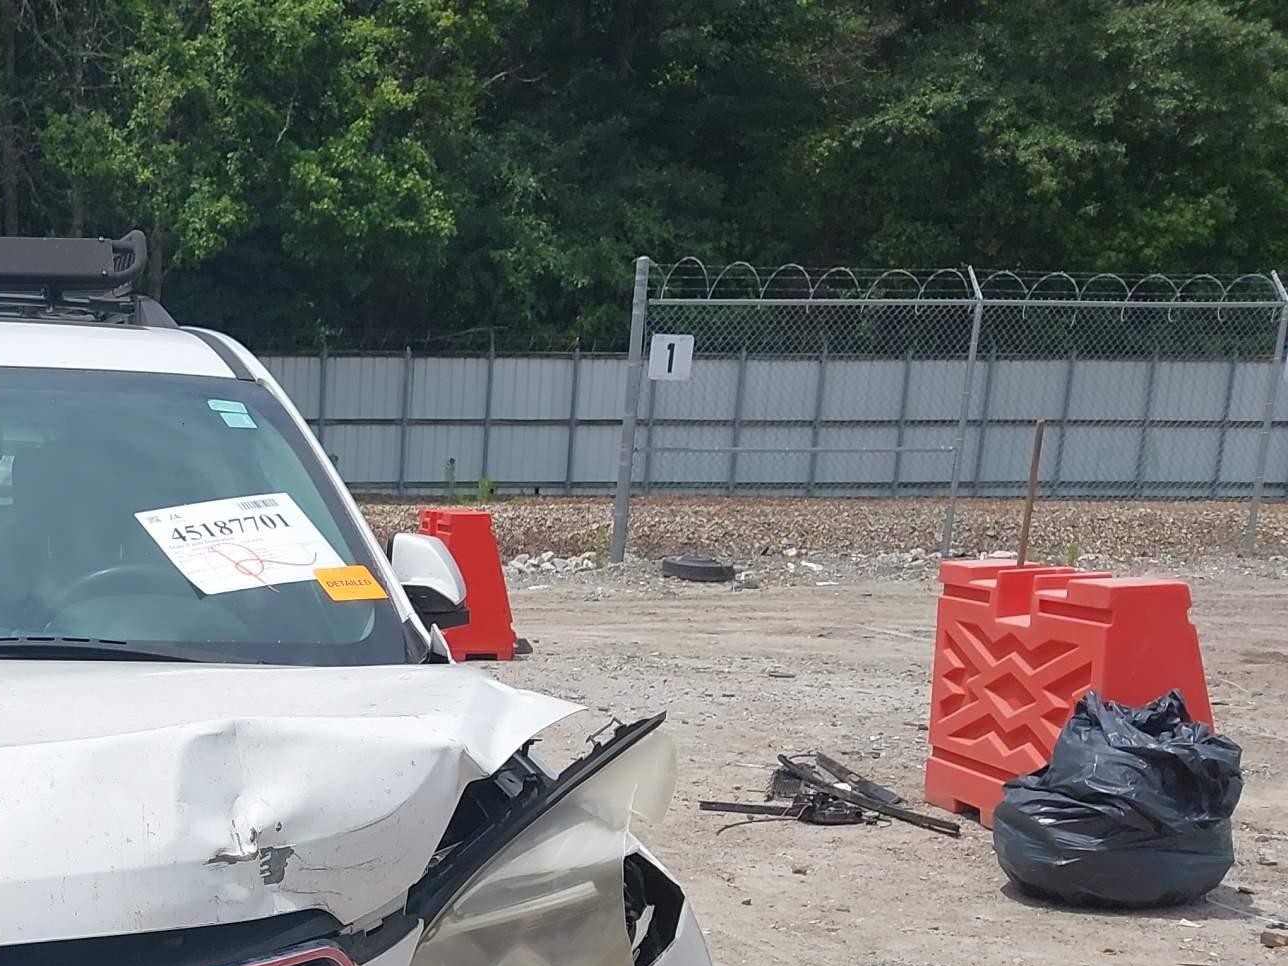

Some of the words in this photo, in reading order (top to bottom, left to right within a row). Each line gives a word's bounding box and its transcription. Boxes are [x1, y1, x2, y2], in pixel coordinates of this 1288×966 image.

[666, 342, 676, 374] 1
[171, 513, 291, 542] 45187701
[326, 579, 372, 588] DETAILED
